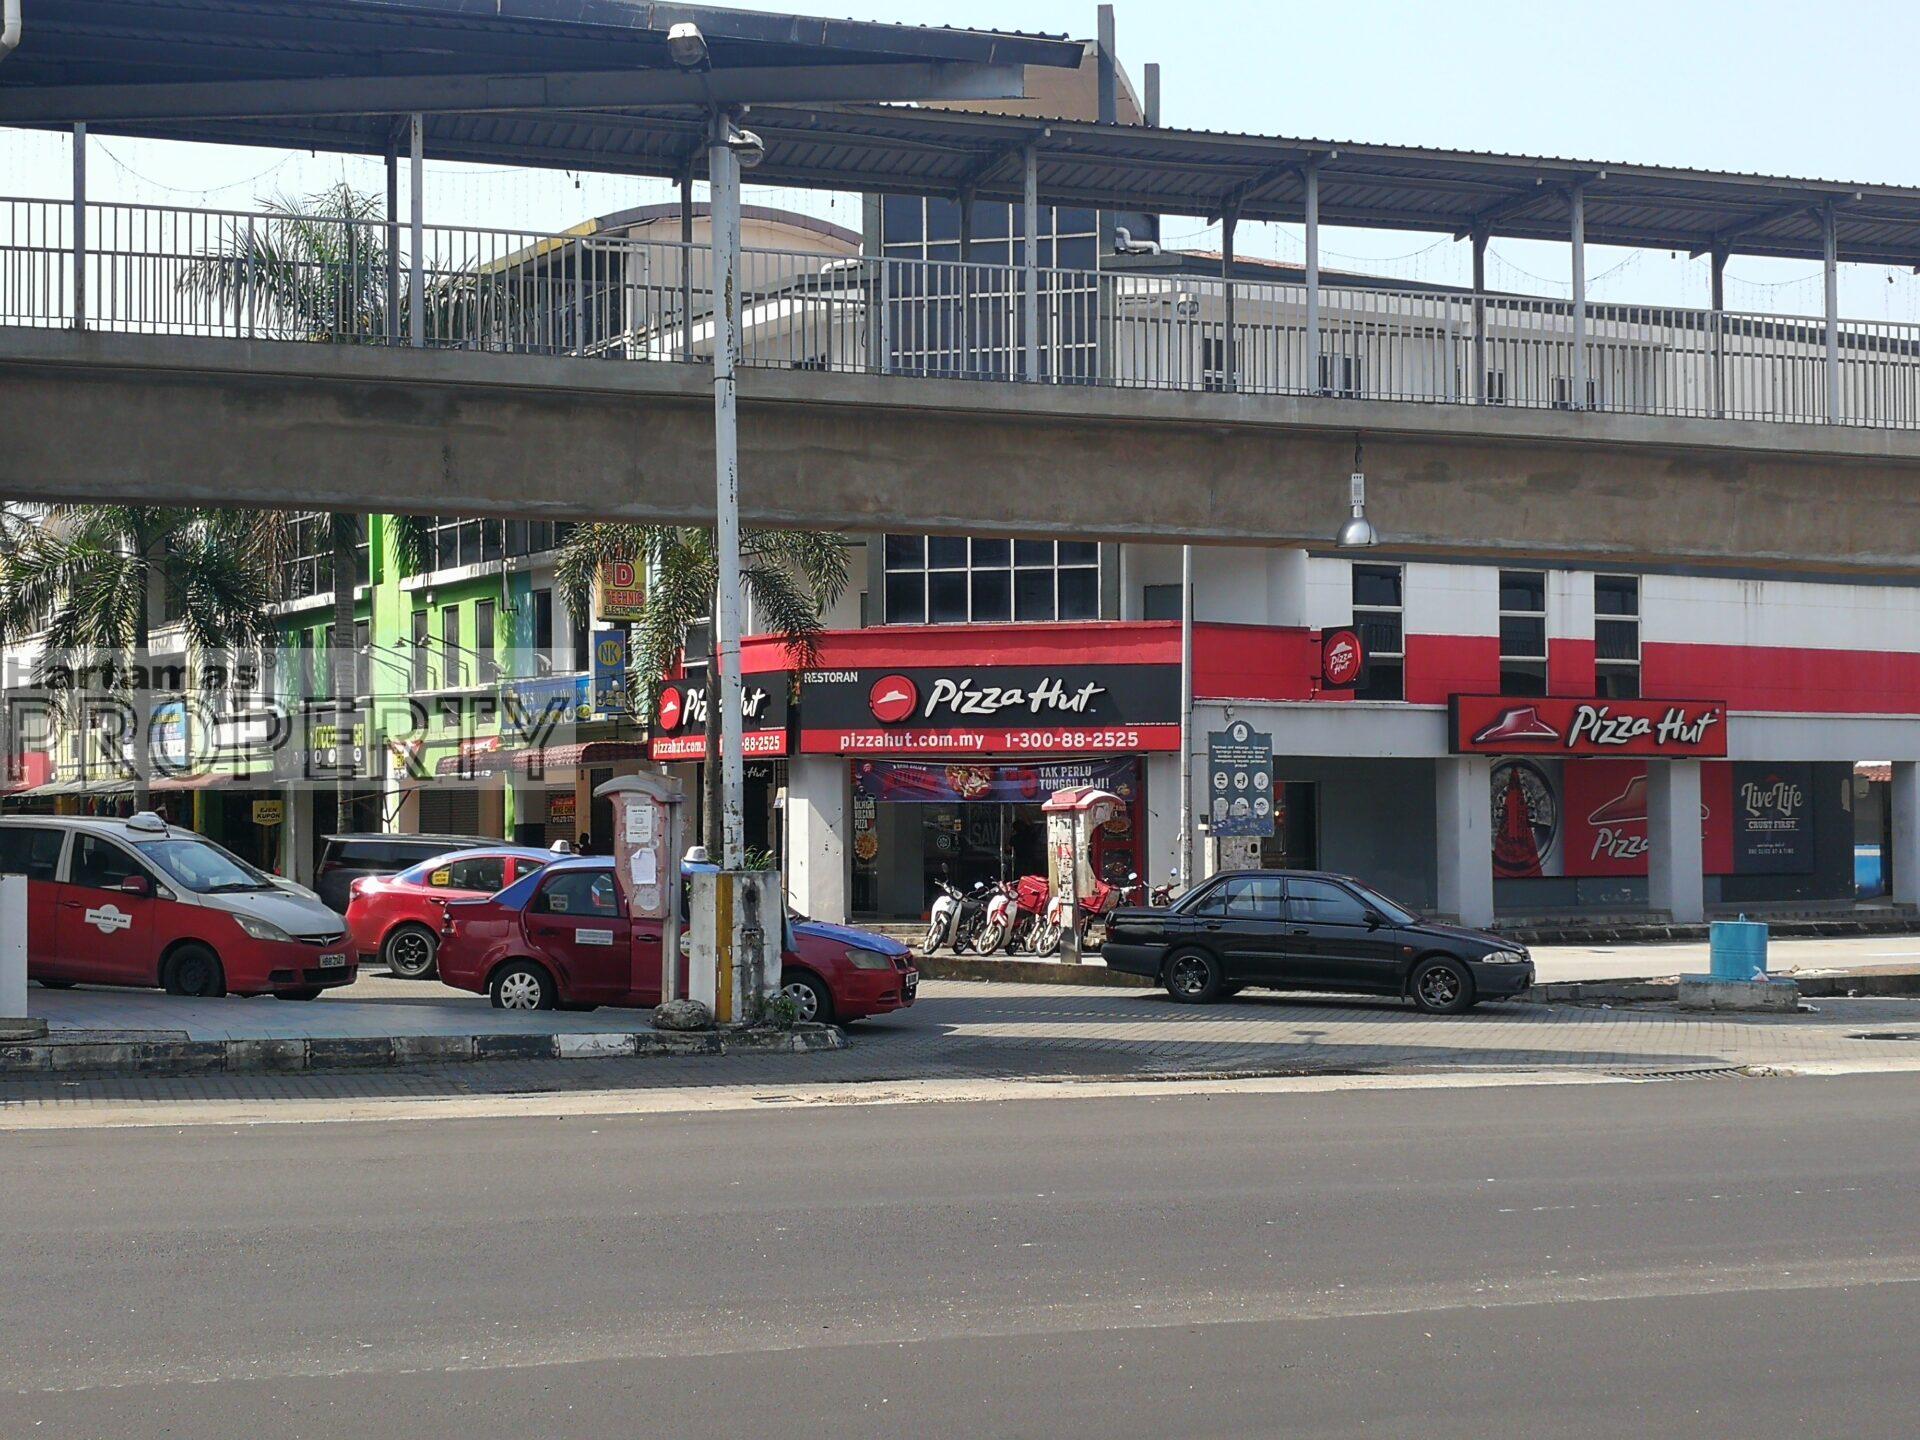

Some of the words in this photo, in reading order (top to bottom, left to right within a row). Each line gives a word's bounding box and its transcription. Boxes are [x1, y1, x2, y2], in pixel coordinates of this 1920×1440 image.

[604, 589, 645, 606] TECHNIC
[604, 605, 645, 615] ELECTRONICS
[602, 643, 621, 662] NK
[1331, 652, 1353, 669] Pizza
[1333, 661, 1350, 675] Hut
[804, 671, 858, 683] RESTORAN
[925, 678, 1025, 718] Pizza
[1031, 677, 1105, 714] Hut
[1568, 705, 1652, 748] Pizza
[1656, 707, 1718, 745] Hut
[840, 731, 985, 750] pizzahut.com.my
[1004, 731, 1139, 748] 1-300-88-2525
[1040, 766, 1058, 778] TAK
[1061, 766, 1092, 778] PERLU
[1082, 778, 1110, 790] GAJI!
[1748, 820, 1772, 829] CRUST
[1774, 820, 1796, 829] FIRST
